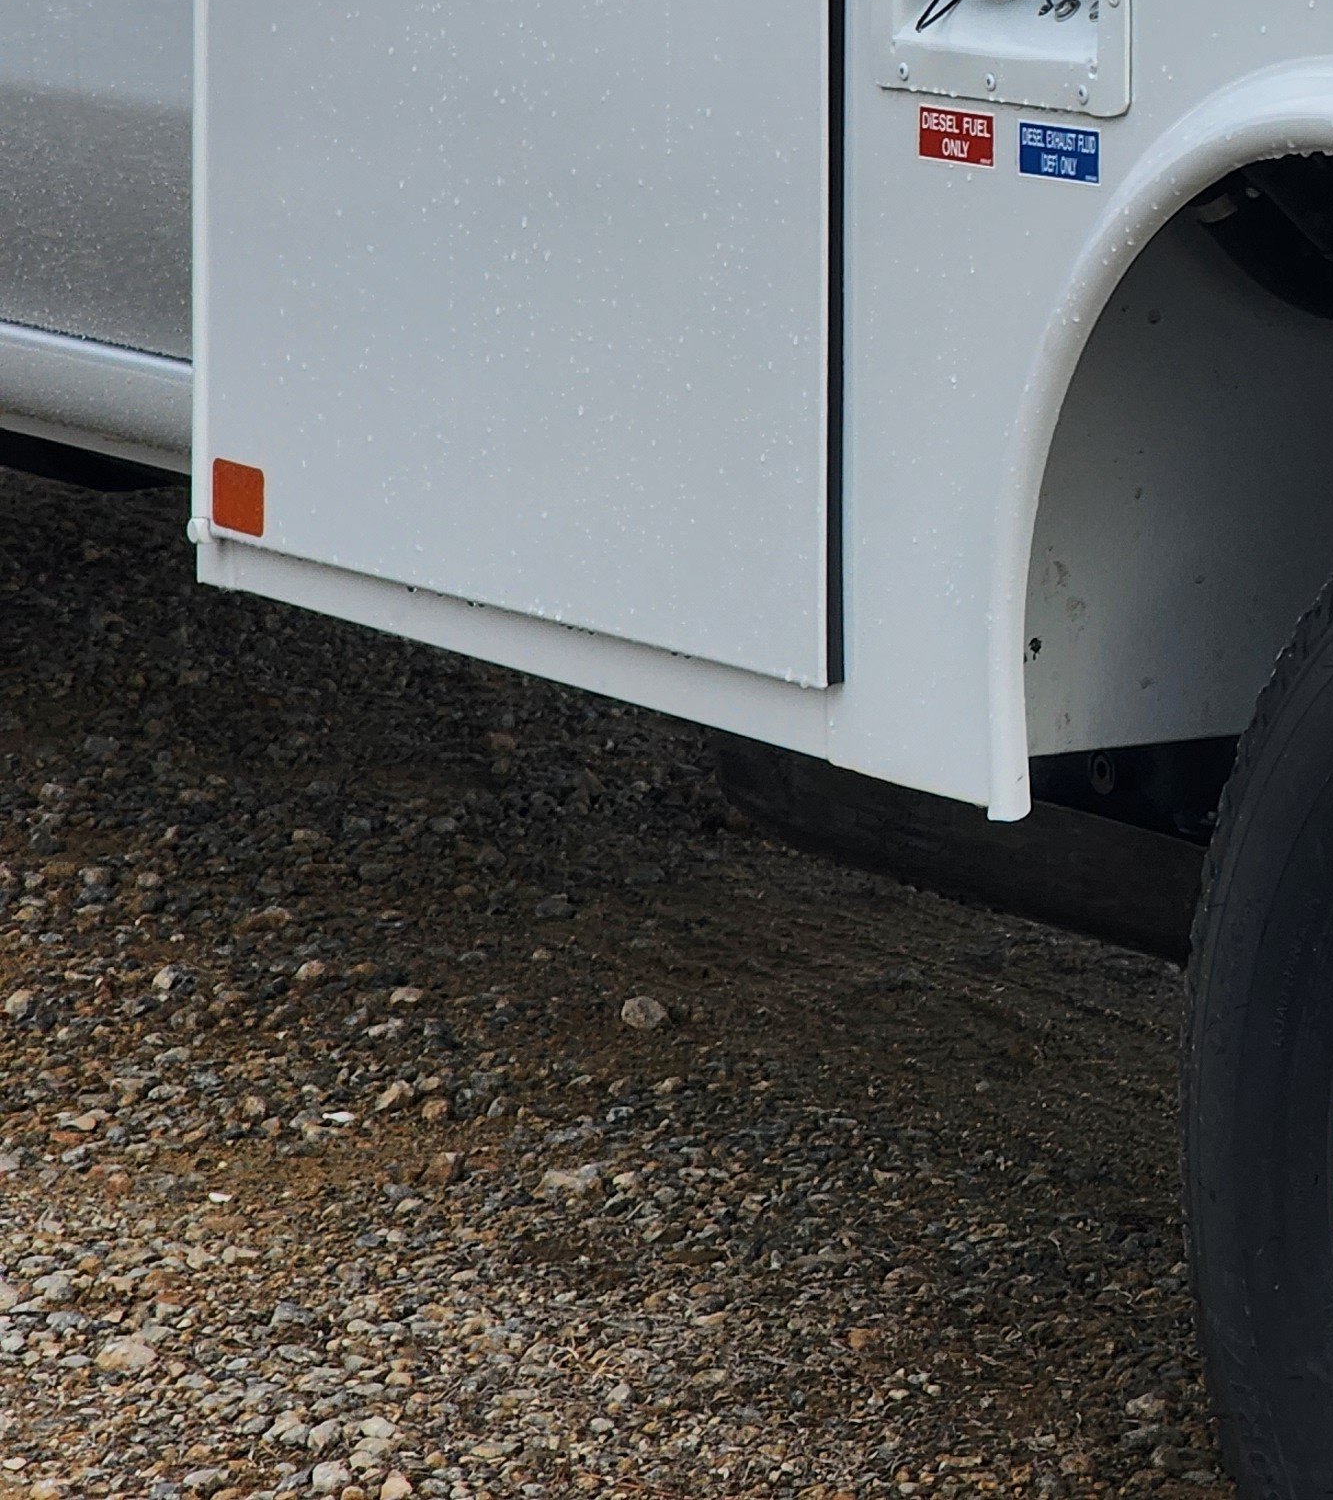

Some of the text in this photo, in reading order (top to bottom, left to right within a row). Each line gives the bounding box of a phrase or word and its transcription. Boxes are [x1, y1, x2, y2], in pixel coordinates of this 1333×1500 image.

[921, 111, 990, 137] DIESEL FUEL
[1022, 126, 1045, 147] DIESEL
[941, 137, 969, 158] ONLY
